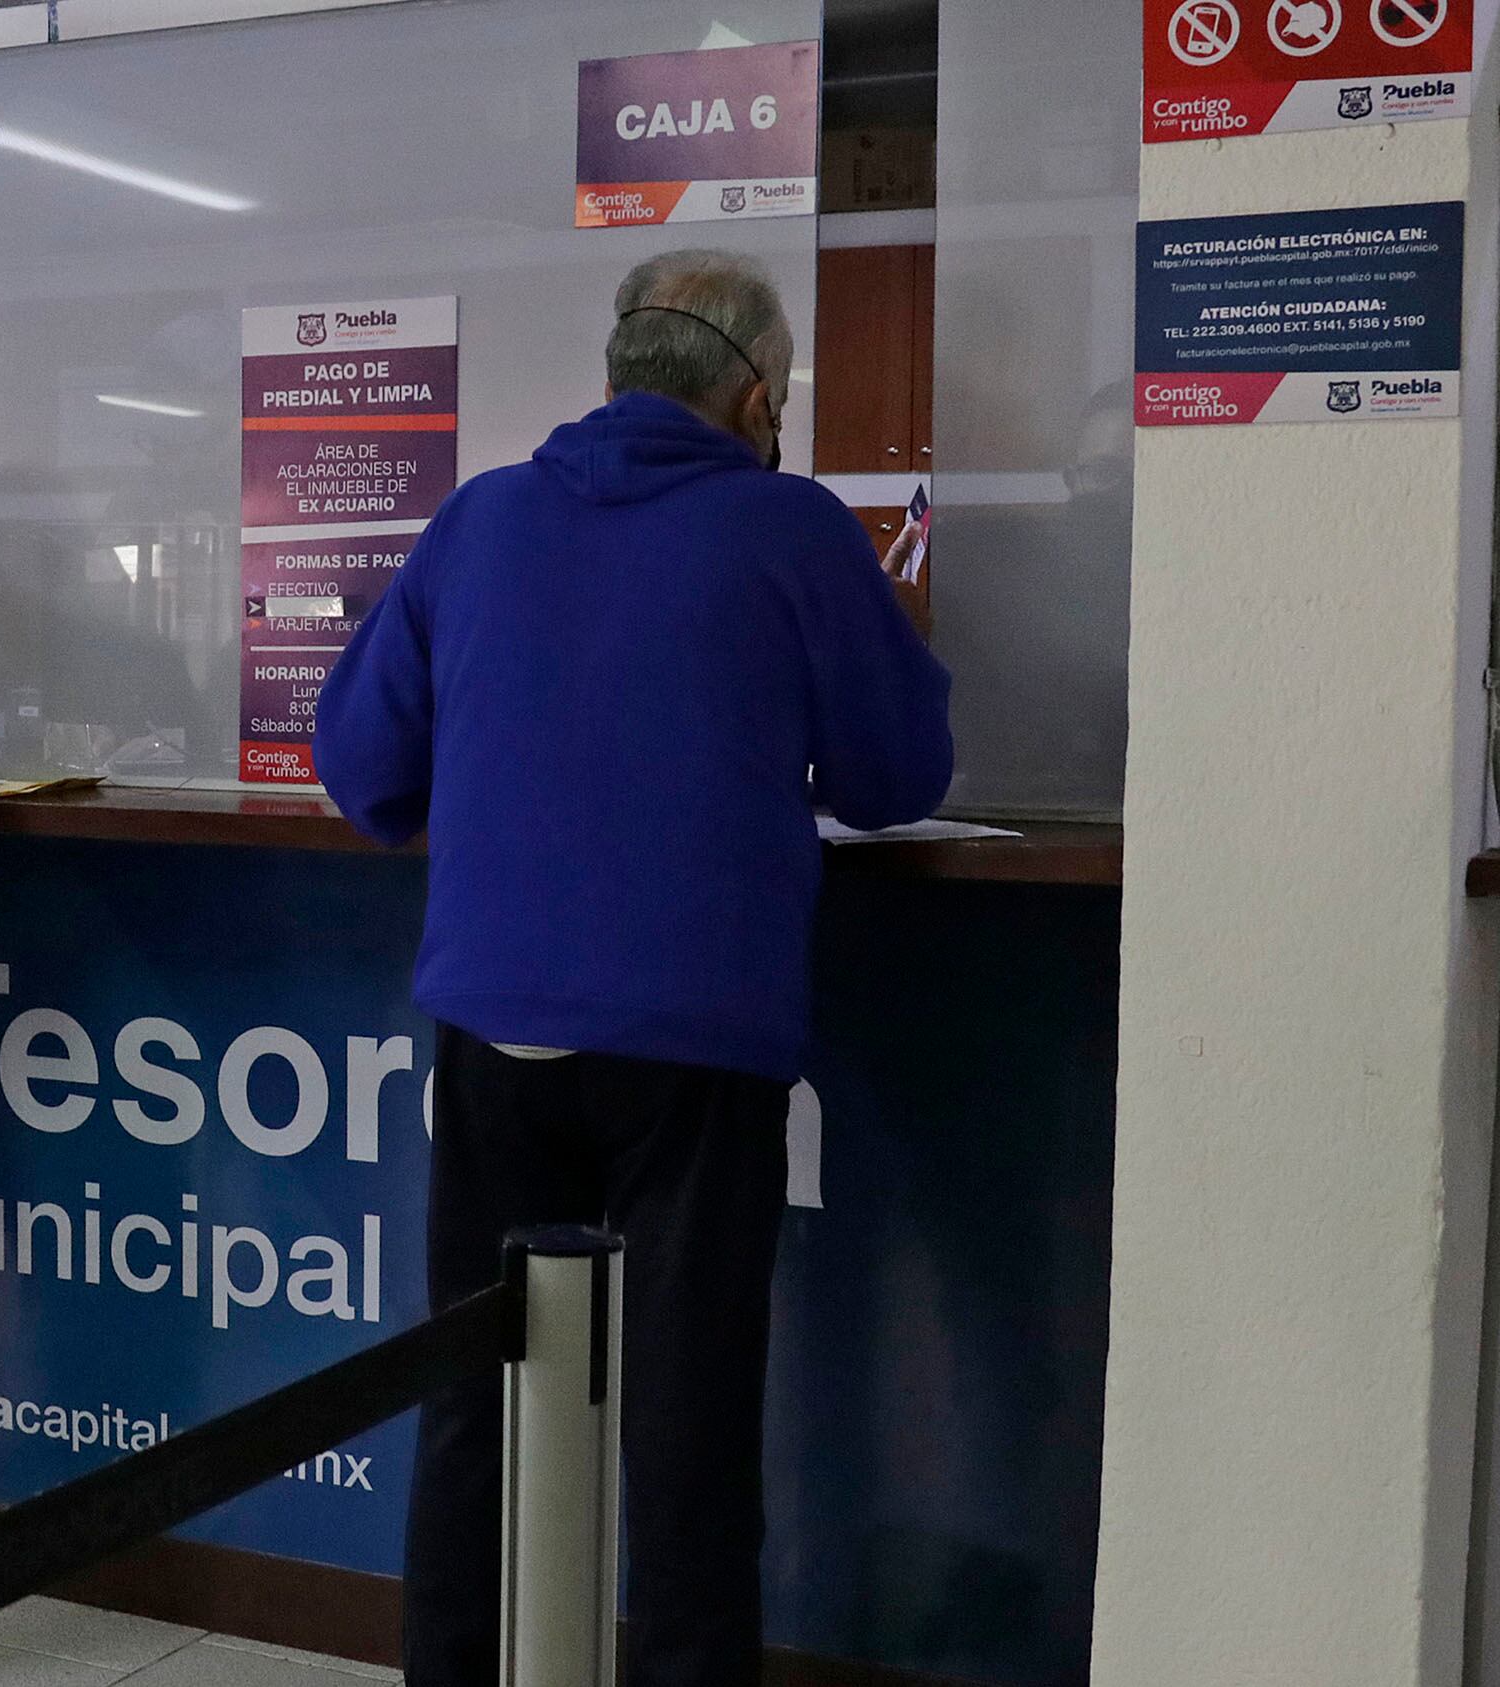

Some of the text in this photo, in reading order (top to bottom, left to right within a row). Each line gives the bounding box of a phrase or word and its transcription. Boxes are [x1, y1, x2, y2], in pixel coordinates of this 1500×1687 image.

[1383, 80, 1455, 100] Puebla
[1153, 96, 1231, 118] Contigo
[616, 95, 777, 140] CAJA 6
[1154, 112, 1248, 132] y con rumbo
[584, 191, 642, 209] Contigo
[753, 184, 805, 198] Puebla
[605, 205, 654, 220] rumbo
[1164, 227, 1427, 256] FACTURACIÓN ELECTRÓNICA EN:
[1171, 282, 1207, 293] Tramite
[1210, 281, 1222, 290] su
[1224, 279, 1260, 290] factura
[1278, 277, 1287, 286] el
[1290, 276, 1312, 285] mes
[1314, 275, 1333, 287] que
[1336, 271, 1371, 283] realizó
[1374, 273, 1386, 281] su
[1200, 299, 1386, 320] ATENCIÓN CIUDADANA:
[335, 310, 397, 328] Puebla
[1163, 315, 1425, 339] TEL: 222.309.4600 EXT. 5141, 5136 y 5190
[1176, 339, 1411, 359] facturacionelectronica@pueblacapital.gob.mx
[304, 361, 389, 381] PAGO DE
[263, 384, 432, 407] PREDIAL Y LIMPIA
[1145, 383, 1221, 405] Contigo
[1371, 378, 1442, 395] Puebla
[1145, 405, 1151, 413] y
[1172, 400, 1238, 418] rumbo
[315, 443, 379, 460] ÁREA DE
[277, 461, 416, 479] ACLARACIONES EN
[287, 479, 407, 496] EL INMUEBLE DE
[298, 497, 395, 513] EX ACUARIO
[276, 553, 411, 569] FORMAS DE PAG
[268, 582, 338, 596] EFECTIVO
[268, 618, 332, 632] TARJETA
[335, 621, 352, 632] (DE
[255, 666, 326, 680] HORARIO
[251, 718, 303, 732] Sábado
[247, 749, 299, 767] Contigo
[266, 764, 310, 777] rumbo
